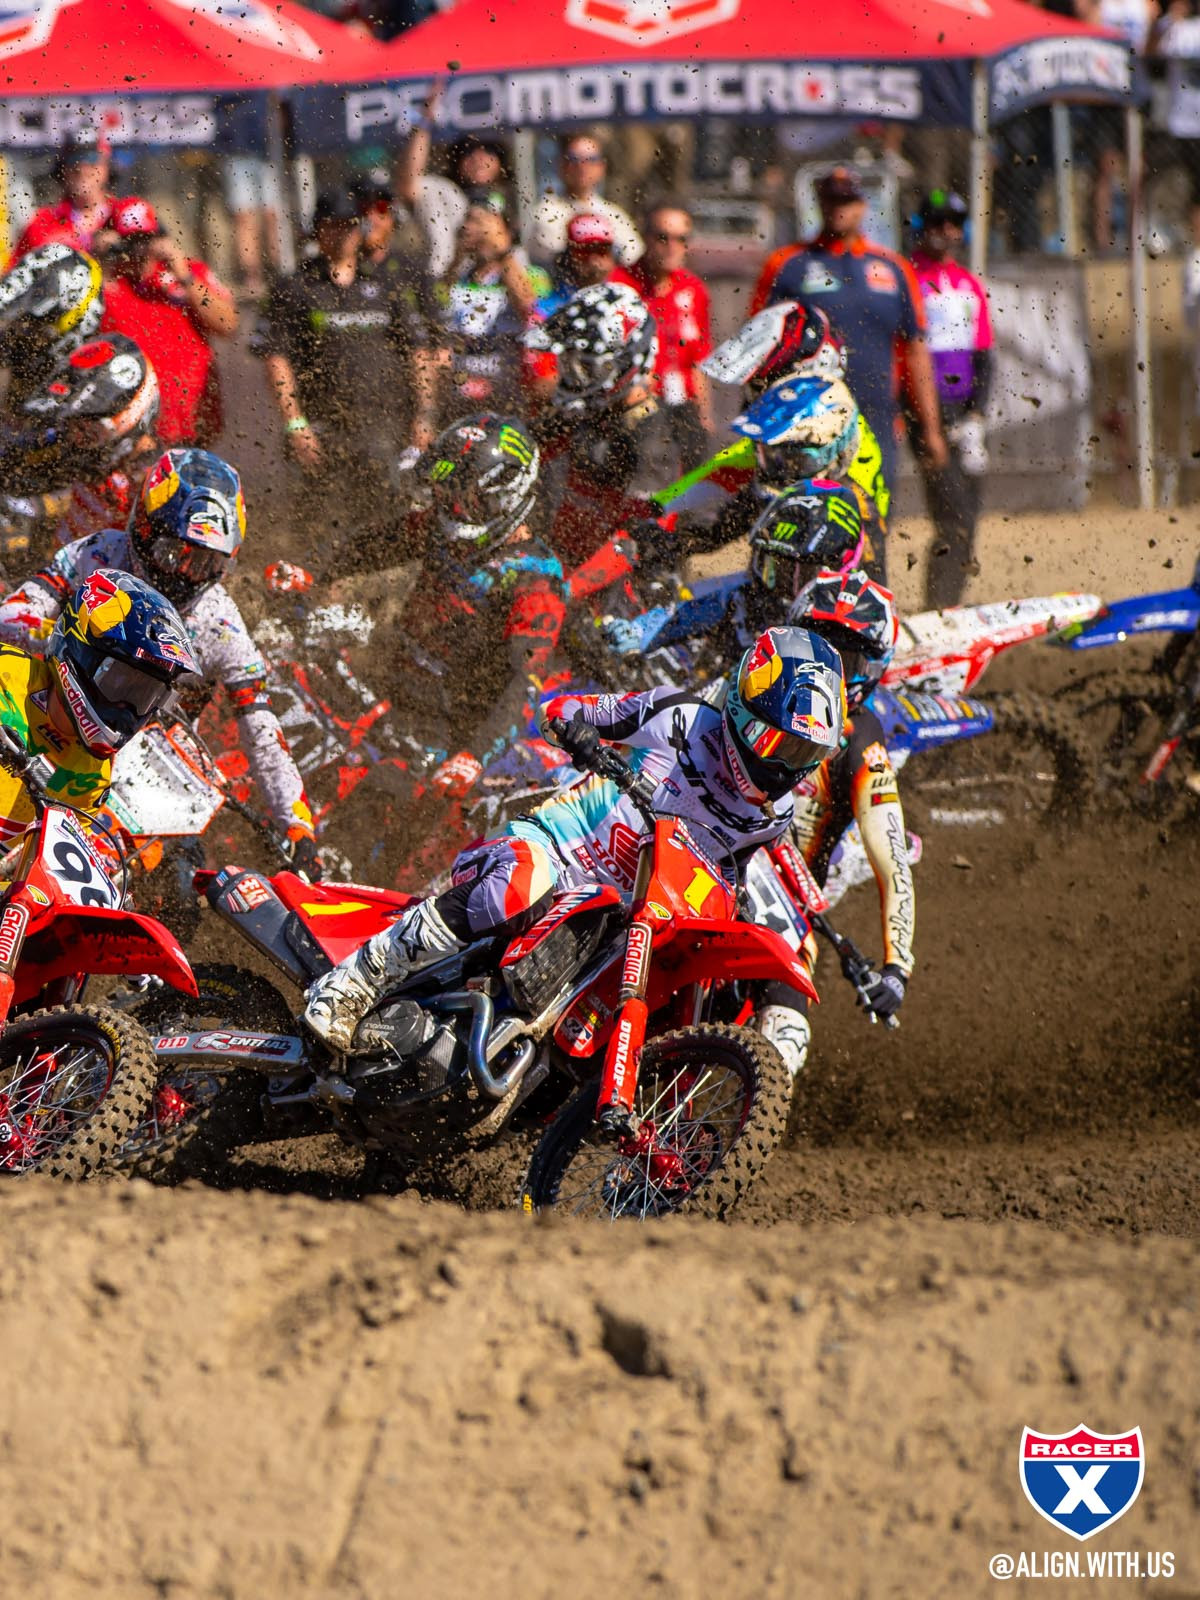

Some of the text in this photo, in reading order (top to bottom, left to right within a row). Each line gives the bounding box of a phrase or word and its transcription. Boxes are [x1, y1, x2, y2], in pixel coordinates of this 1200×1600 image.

[591, 838, 636, 892] HON
[301, 902, 372, 917] 1
[683, 867, 719, 915] 1
[623, 928, 645, 985] SHOWA
[158, 1037, 188, 1049] DID
[613, 1020, 632, 1087] DUNLOP
